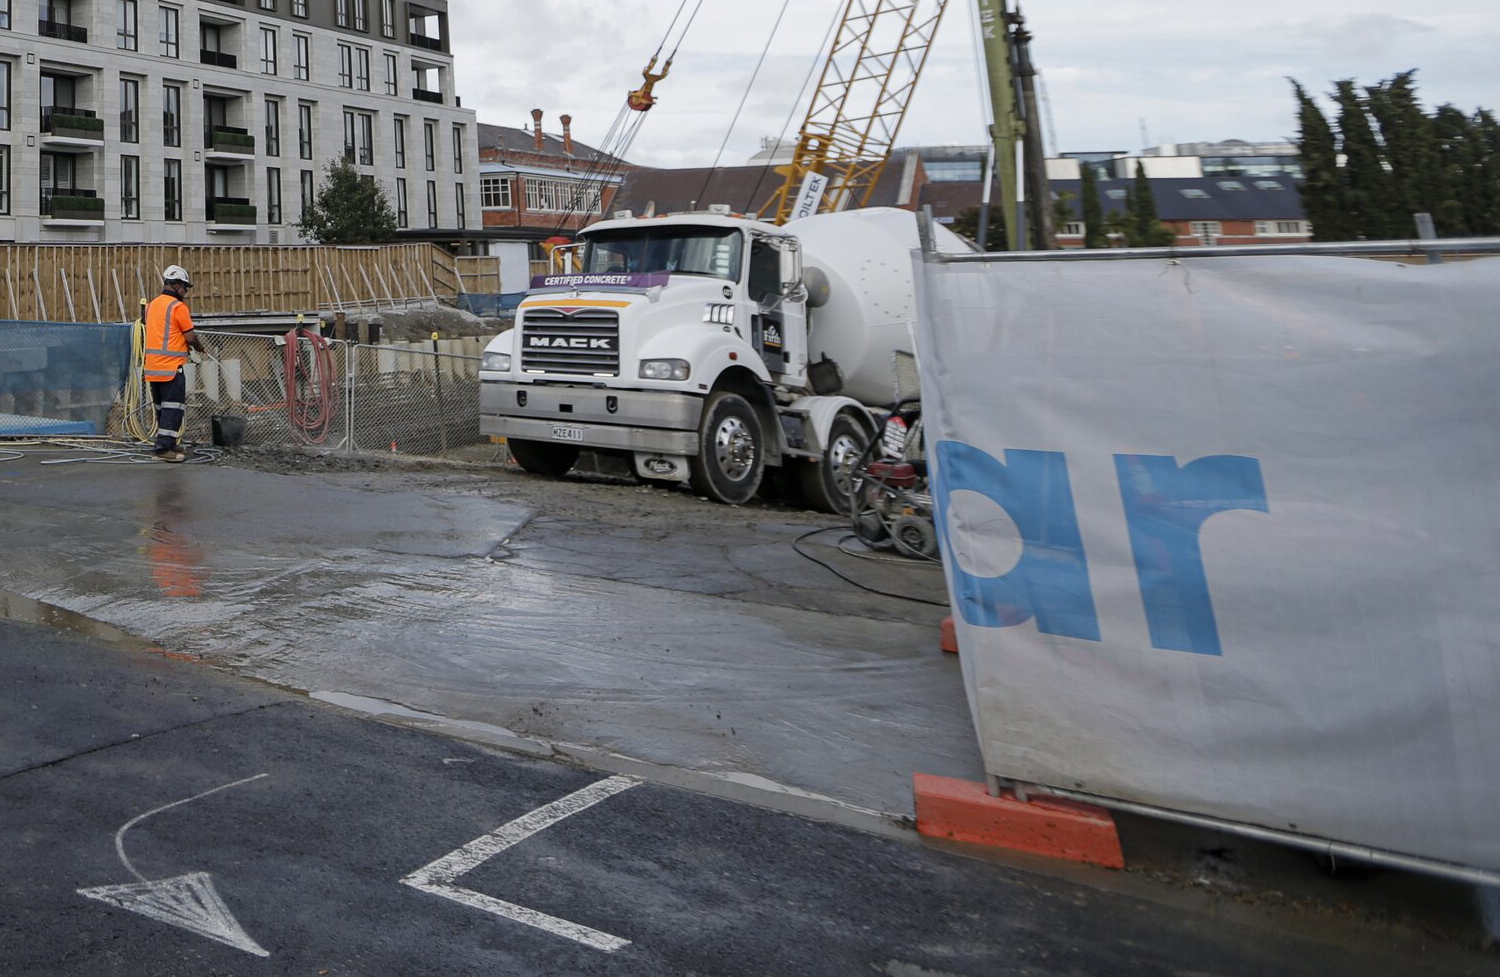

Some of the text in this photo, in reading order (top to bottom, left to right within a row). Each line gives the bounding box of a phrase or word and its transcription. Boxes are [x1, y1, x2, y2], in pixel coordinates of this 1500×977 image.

[799, 175, 822, 218] OILTEK
[544, 276, 583, 286] CERTIFIED
[529, 337, 611, 349] MACK
